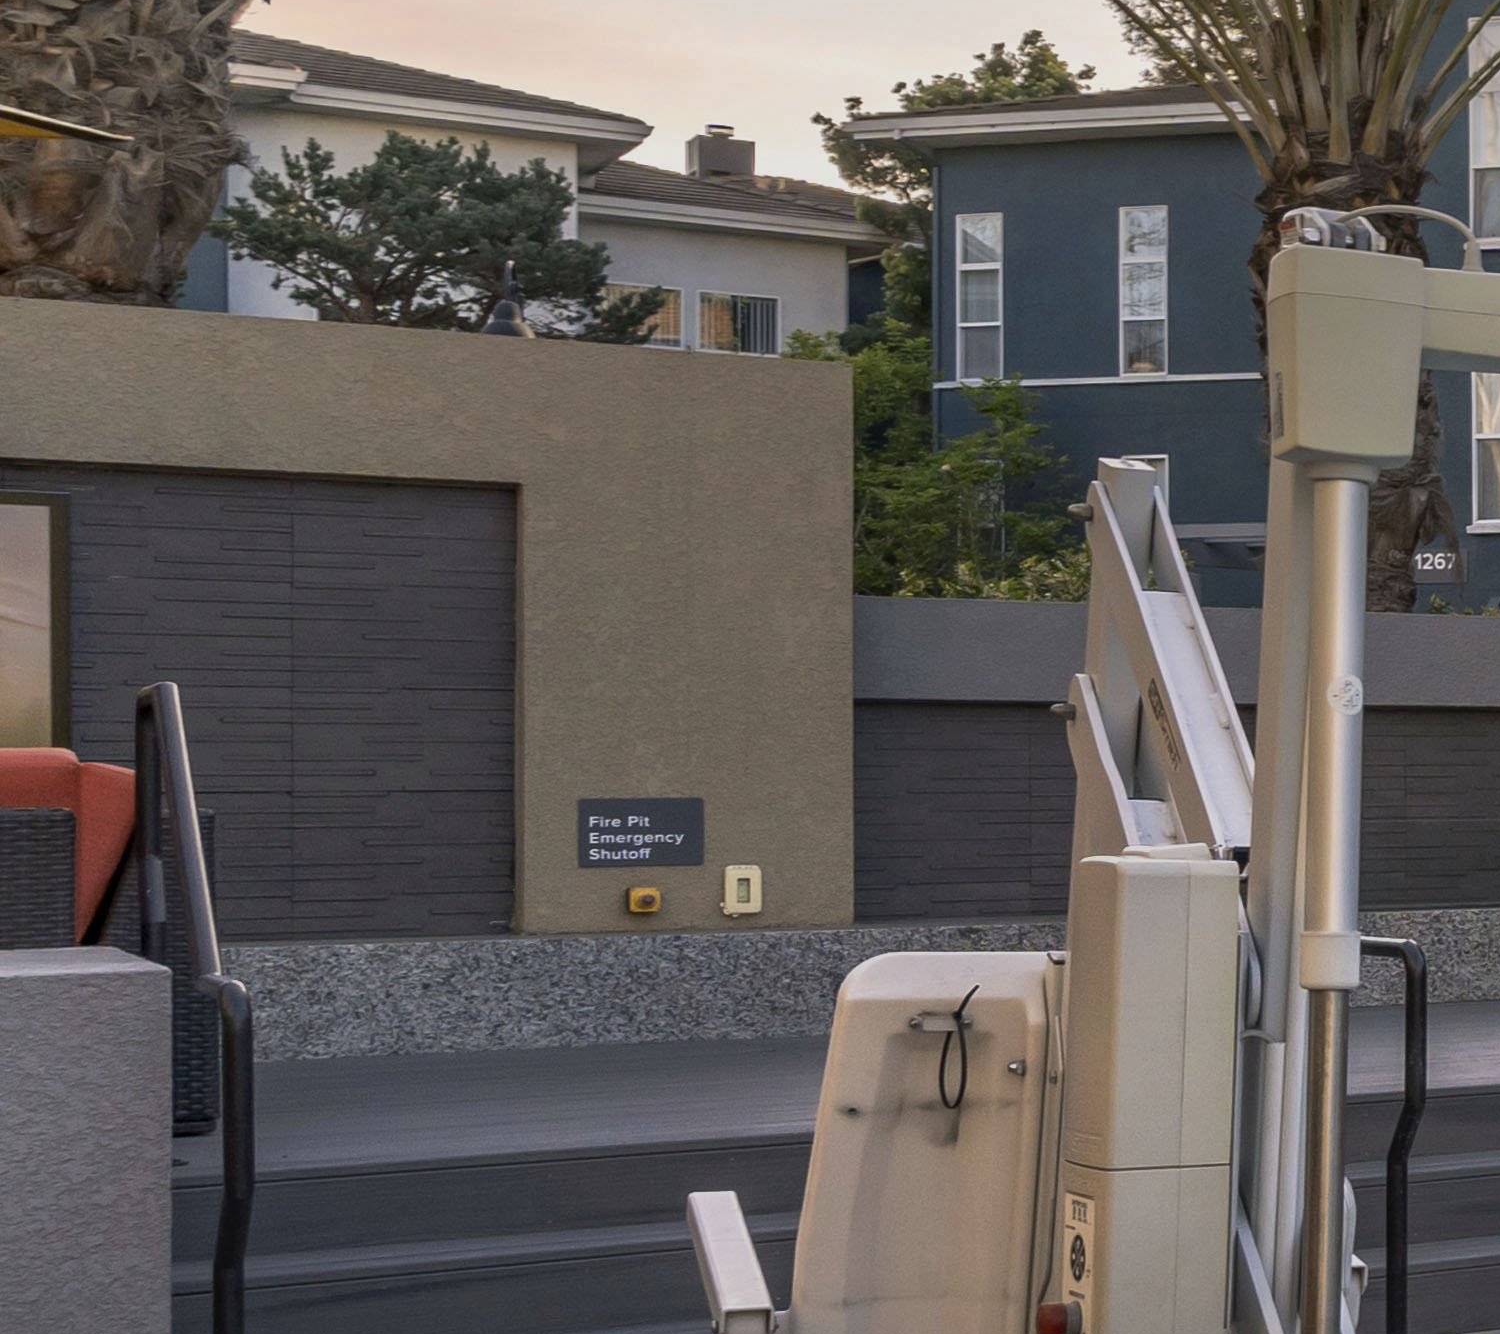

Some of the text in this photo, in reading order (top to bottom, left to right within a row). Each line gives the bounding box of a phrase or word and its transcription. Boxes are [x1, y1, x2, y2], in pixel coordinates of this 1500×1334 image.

[1414, 553, 1456, 570] 1267
[589, 816, 650, 828] Fire Pit
[589, 832, 685, 845] Emergency
[589, 848, 652, 860] Shutoff
